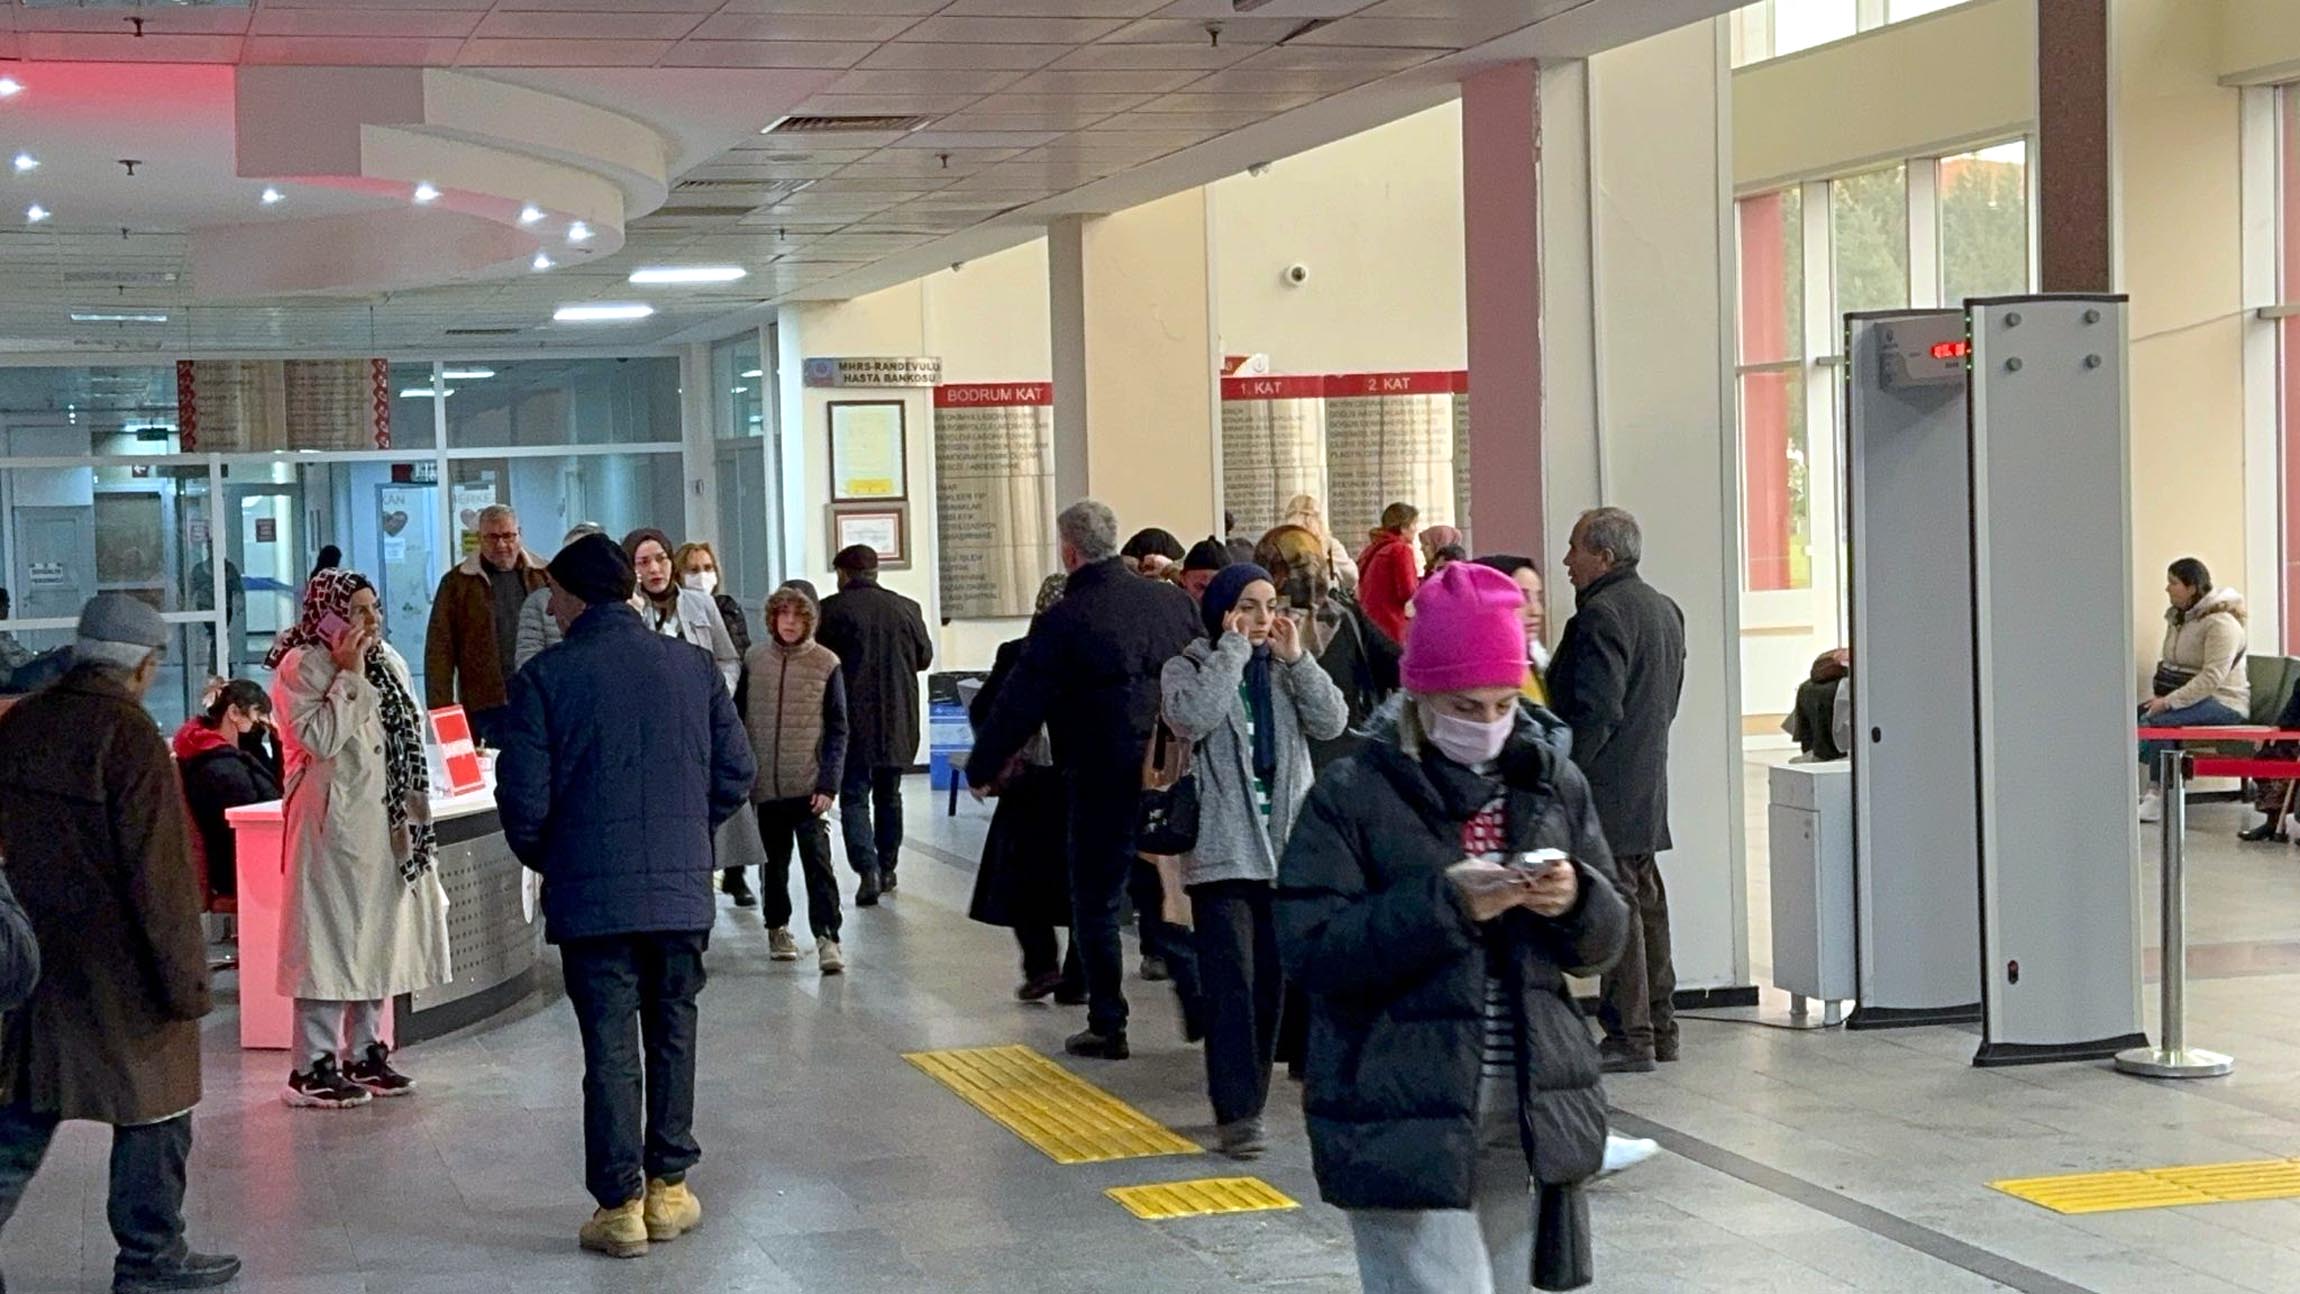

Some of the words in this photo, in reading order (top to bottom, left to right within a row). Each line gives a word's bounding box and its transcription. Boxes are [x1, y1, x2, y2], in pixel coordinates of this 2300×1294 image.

[843, 373, 882, 383] HASTA
[883, 373, 937, 383] BANKOSU
[1383, 377, 1411, 390] KAT
[947, 387, 1012, 402] BODRUM
[1016, 386, 1044, 401] KAT
[1254, 381, 1282, 394] KAT
